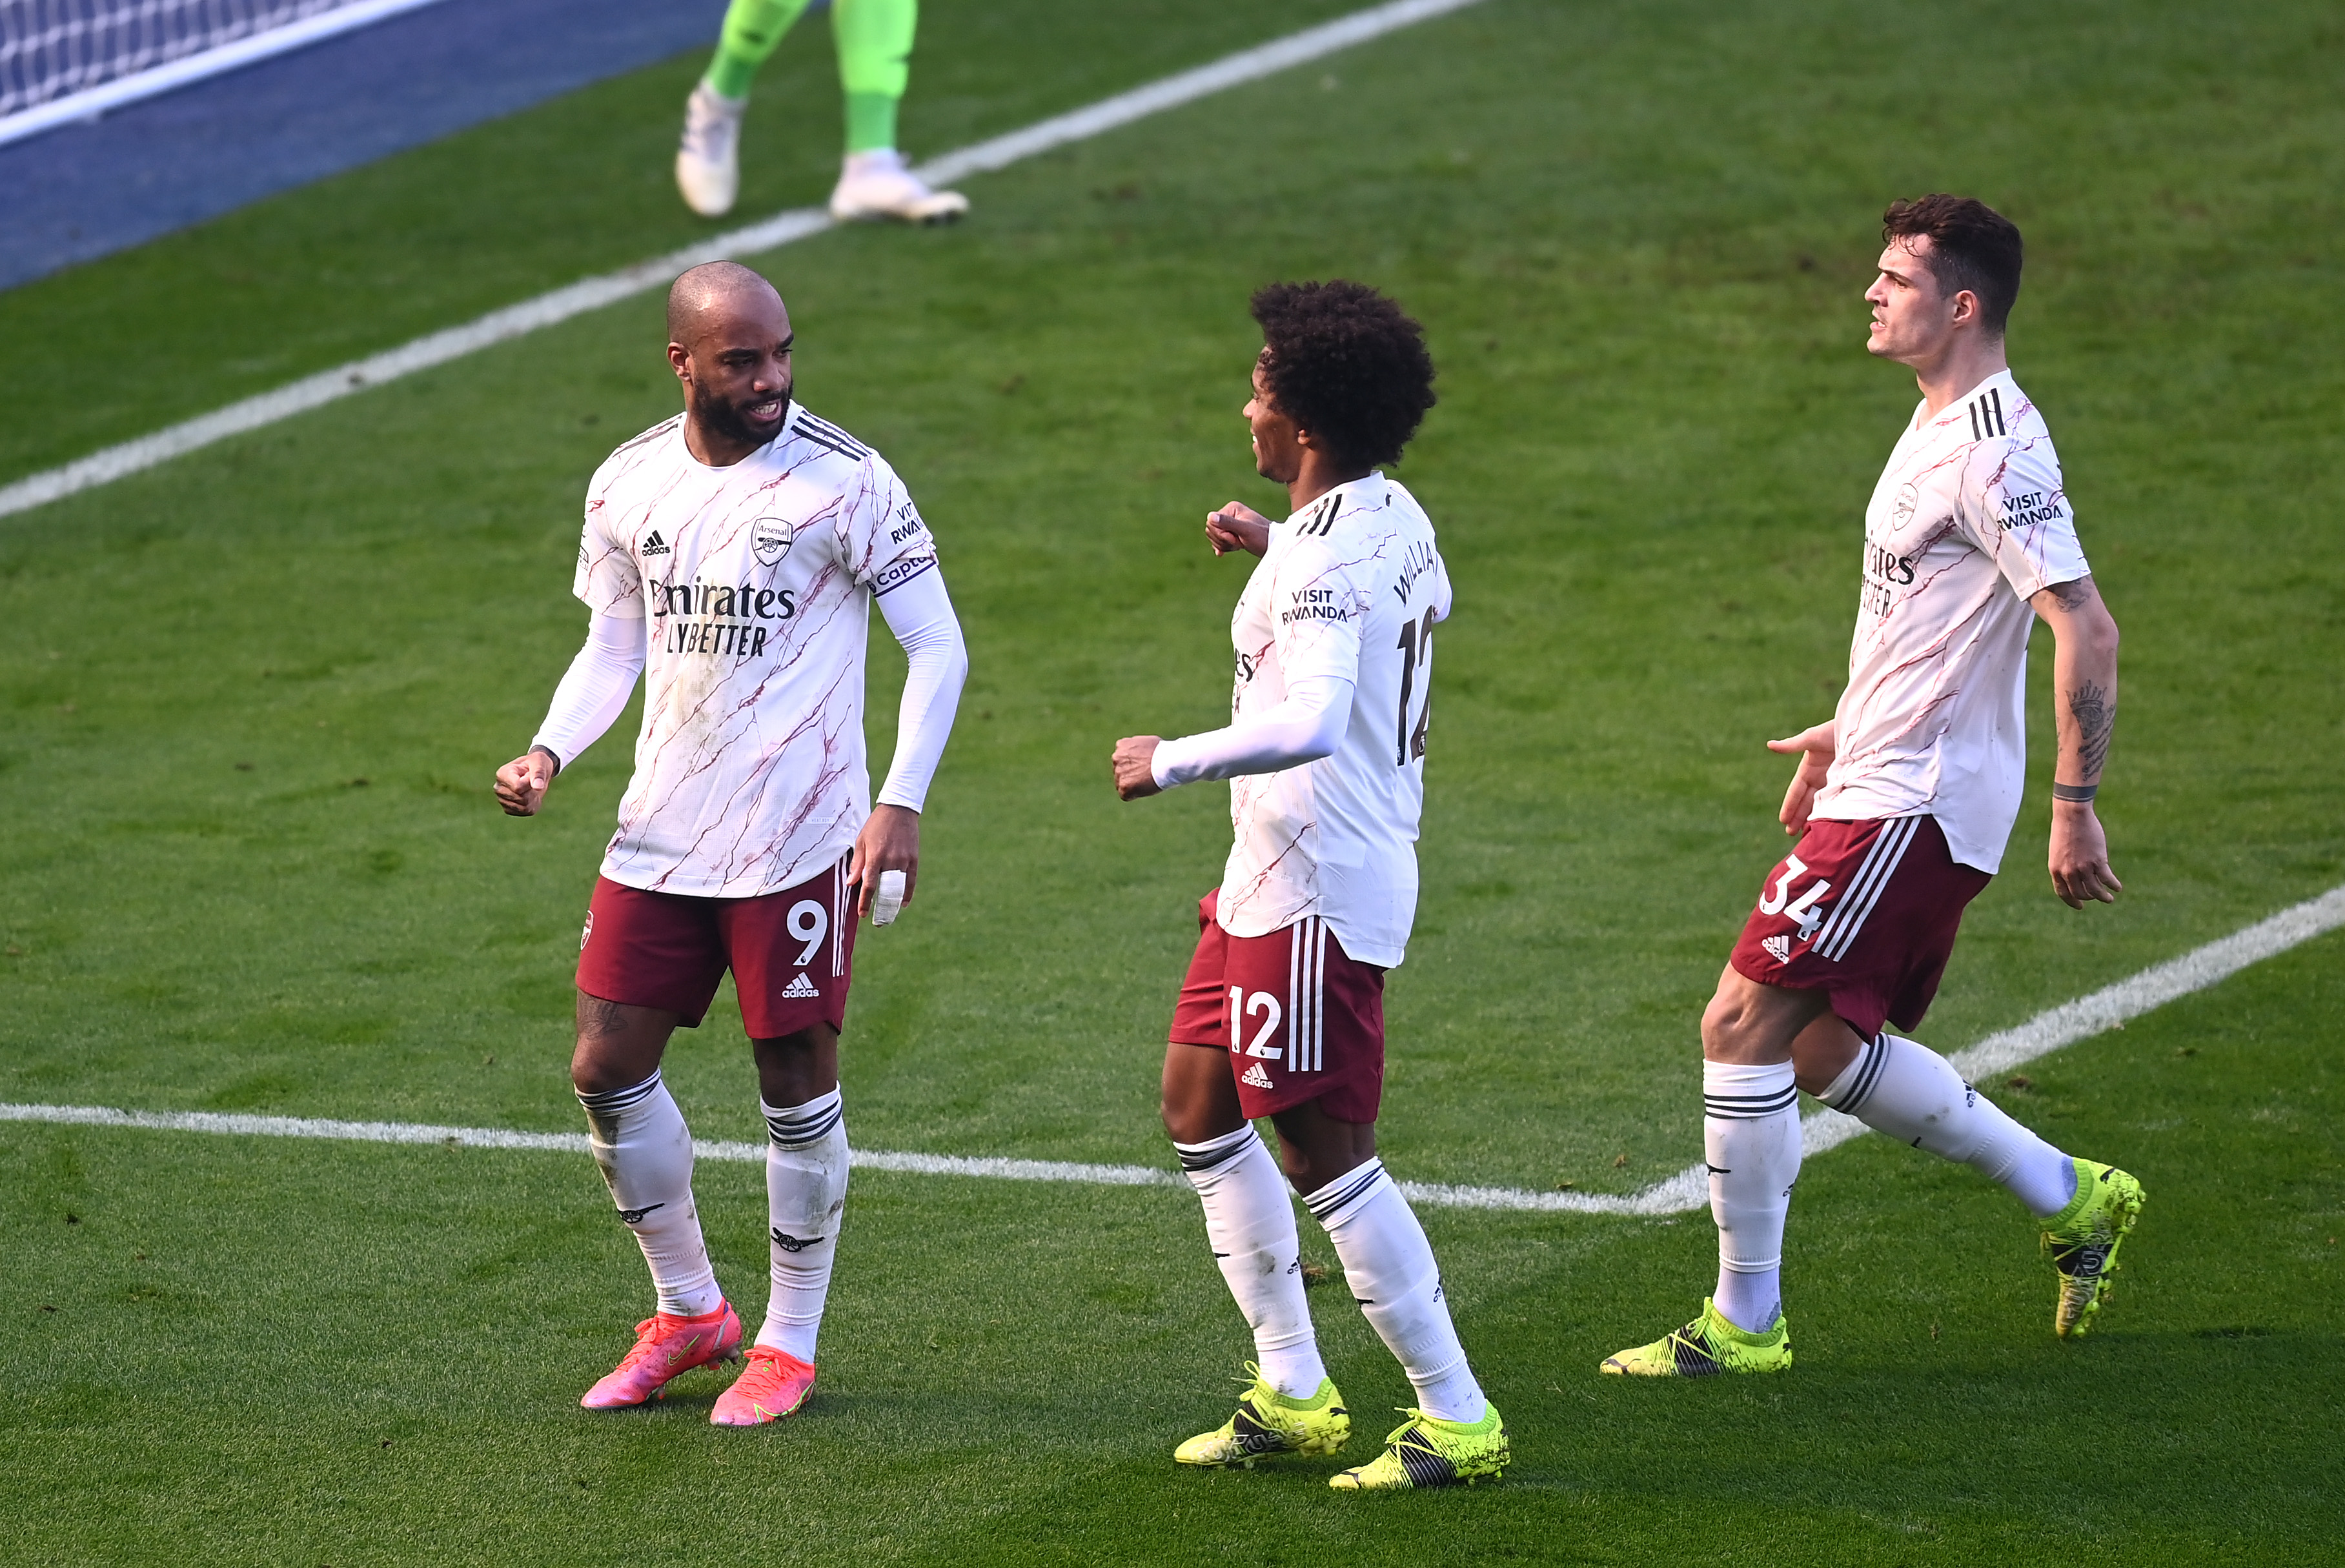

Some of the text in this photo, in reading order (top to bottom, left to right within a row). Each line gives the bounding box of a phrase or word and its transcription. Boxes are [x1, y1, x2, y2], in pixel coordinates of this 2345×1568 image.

[2002, 491, 2043, 512] VISIT
[758, 524, 787, 537] Arsenal
[1997, 505, 2064, 532] RWANDA
[642, 546, 671, 557] adidas
[877, 556, 928, 586] Capta
[1393, 540, 1438, 608] WILLIA
[1292, 589, 1333, 604] VISIT
[1282, 605, 1348, 626] RWANDA
[1759, 853, 1831, 941] 34
[786, 899, 828, 966] 9
[1761, 938, 1790, 965] adidas
[782, 989, 819, 998] adidas
[1228, 985, 1283, 1060] 12
[1241, 1074, 1274, 1089] adidas
